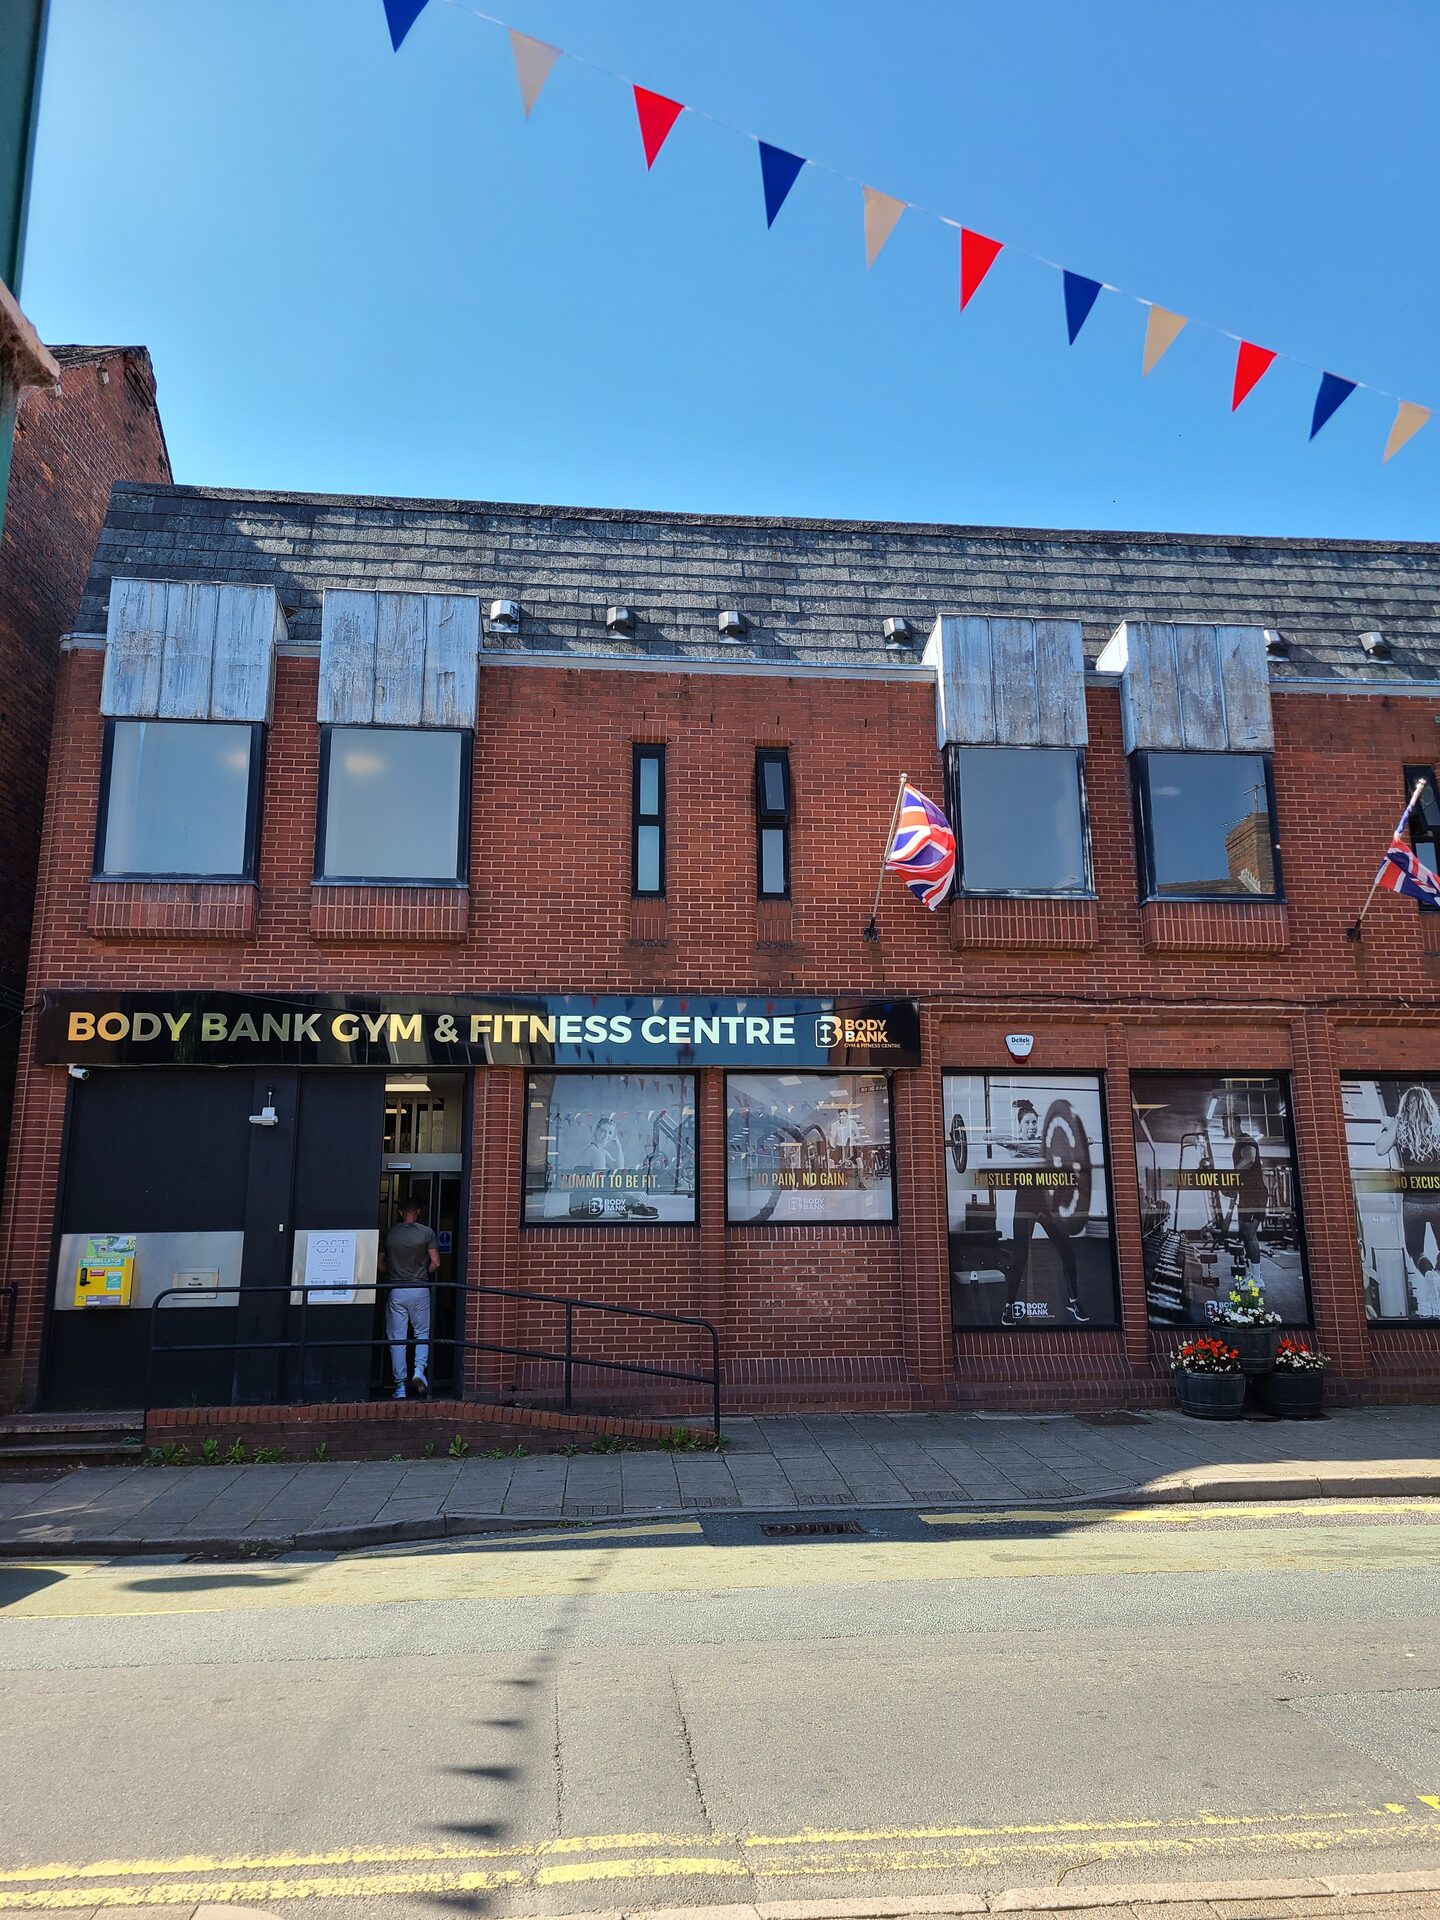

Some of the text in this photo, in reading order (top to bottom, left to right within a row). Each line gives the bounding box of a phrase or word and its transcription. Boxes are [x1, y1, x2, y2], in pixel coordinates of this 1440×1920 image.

[67, 1011, 796, 1045] BODY BANK GYM & FITNESS CENTRE
[844, 1019, 887, 1031] BODY
[844, 1031, 889, 1043] BANK
[608, 1173, 623, 1188] TO
[625, 1174, 639, 1188] BE
[641, 1174, 661, 1188] FIT.
[754, 1172, 849, 1188] NO PAIN, NO GAIN.
[1014, 1172, 1033, 1186] FOR
[1036, 1172, 1078, 1187] MUSCLE.
[1195, 1173, 1219, 1187] LOVE
[1221, 1173, 1244, 1187] LIFT.
[1394, 1176, 1408, 1189] NO
